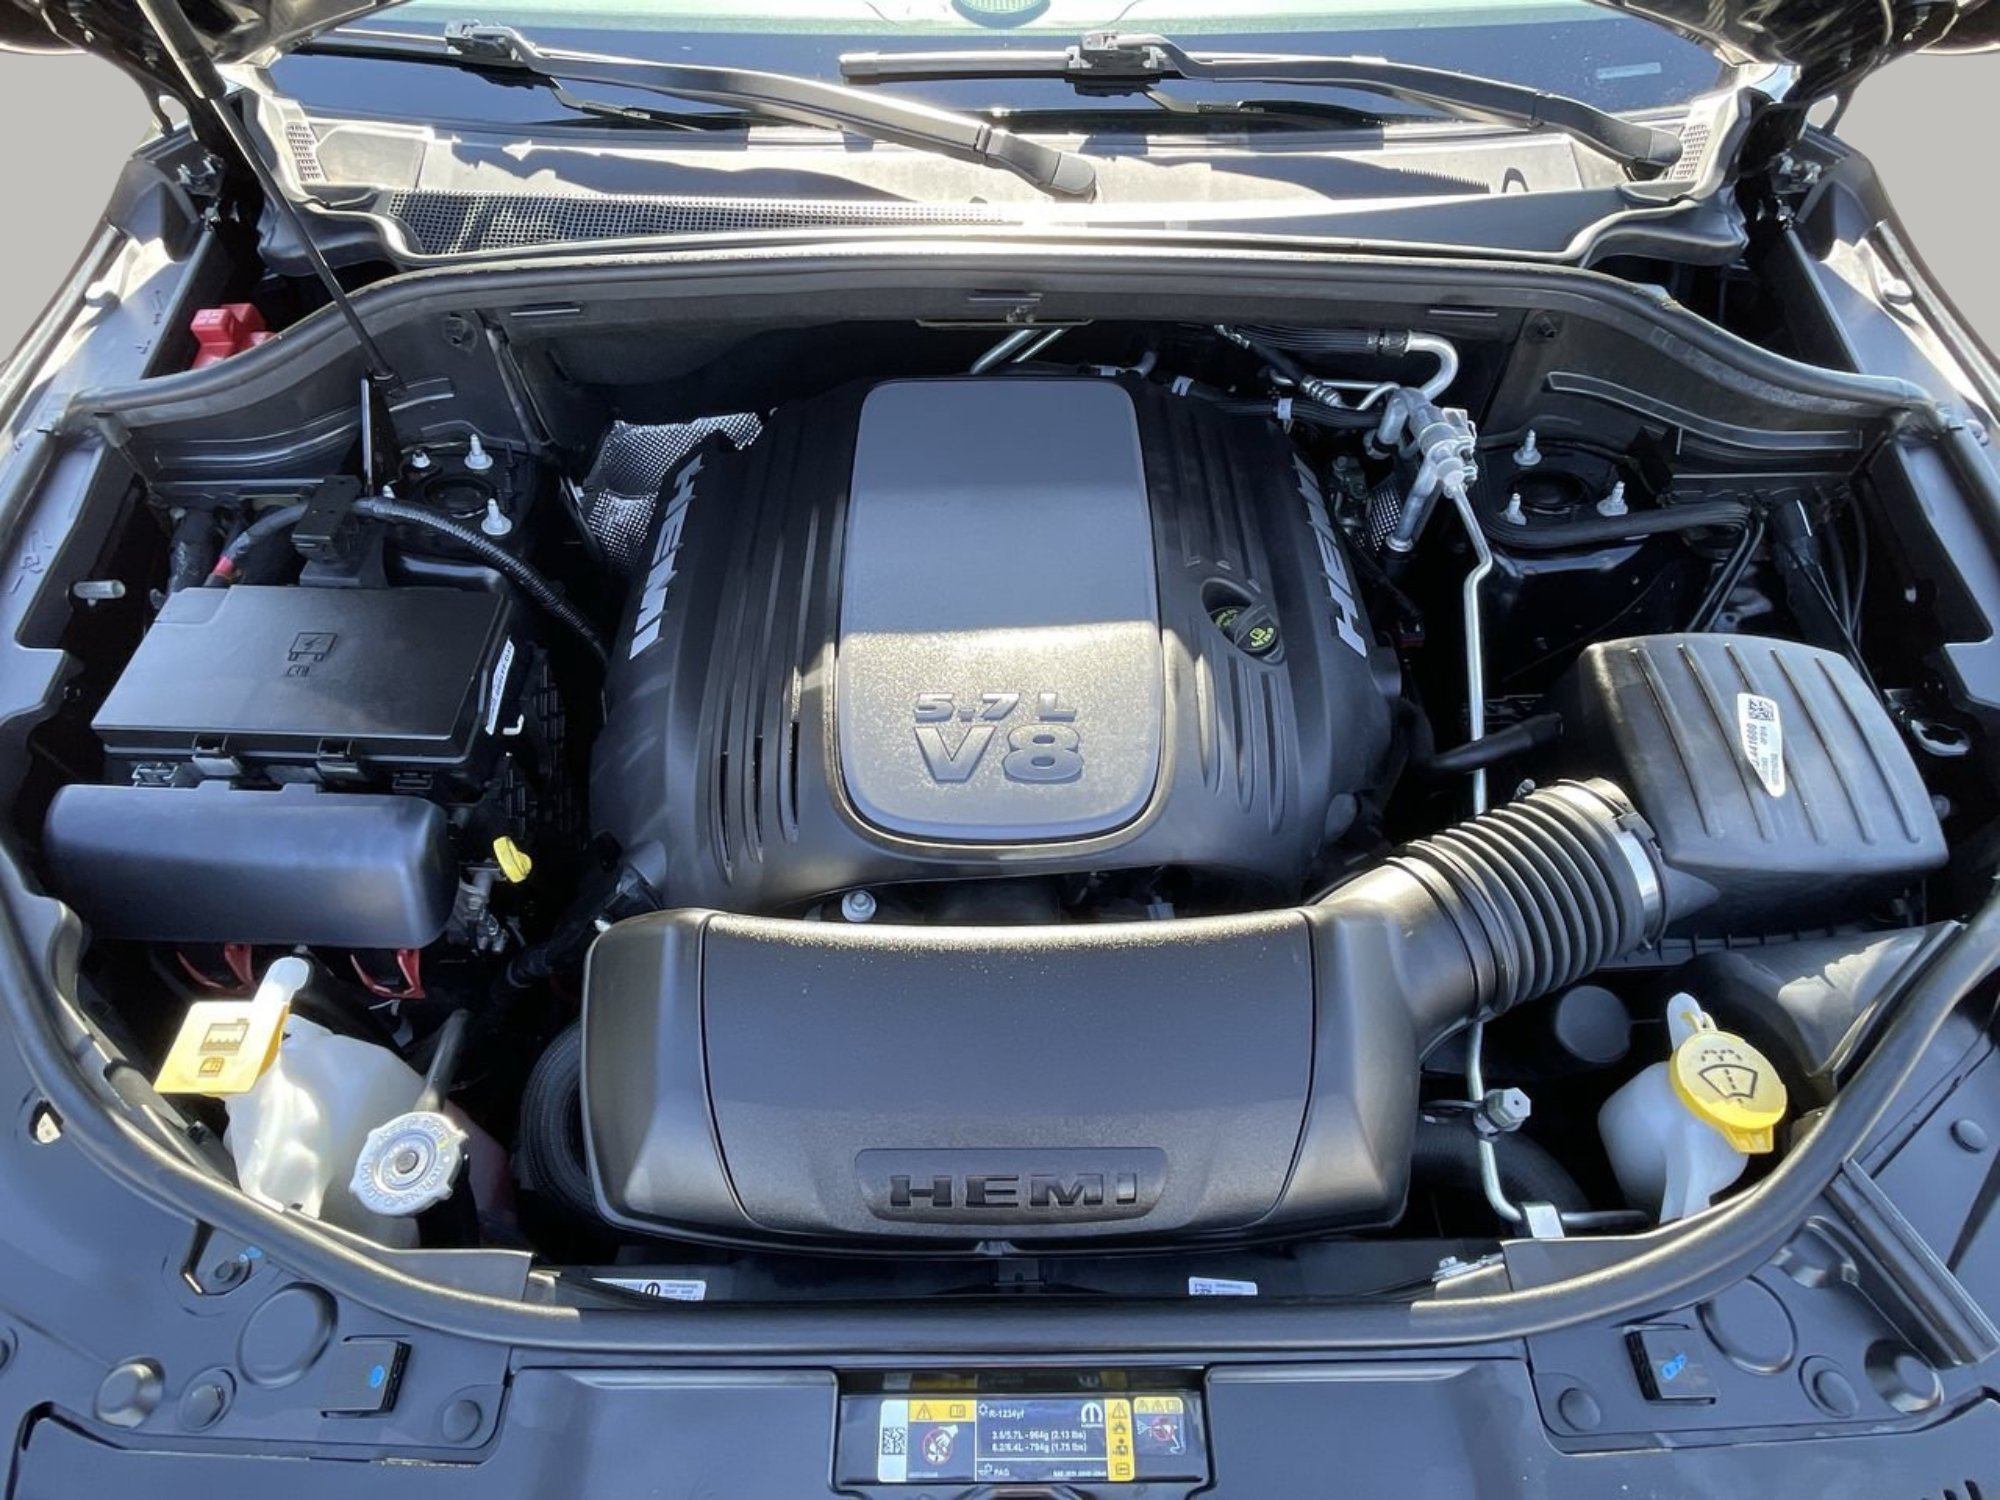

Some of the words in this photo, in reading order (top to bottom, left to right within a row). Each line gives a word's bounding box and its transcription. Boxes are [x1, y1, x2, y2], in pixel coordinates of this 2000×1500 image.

[629, 453, 704, 660] HEMI
[1291, 453, 1367, 658] HEMI
[913, 724, 1084, 784] V8
[890, 1172, 1137, 1208] HEMI
[988, 1408, 1025, 1421] R-1234yf
